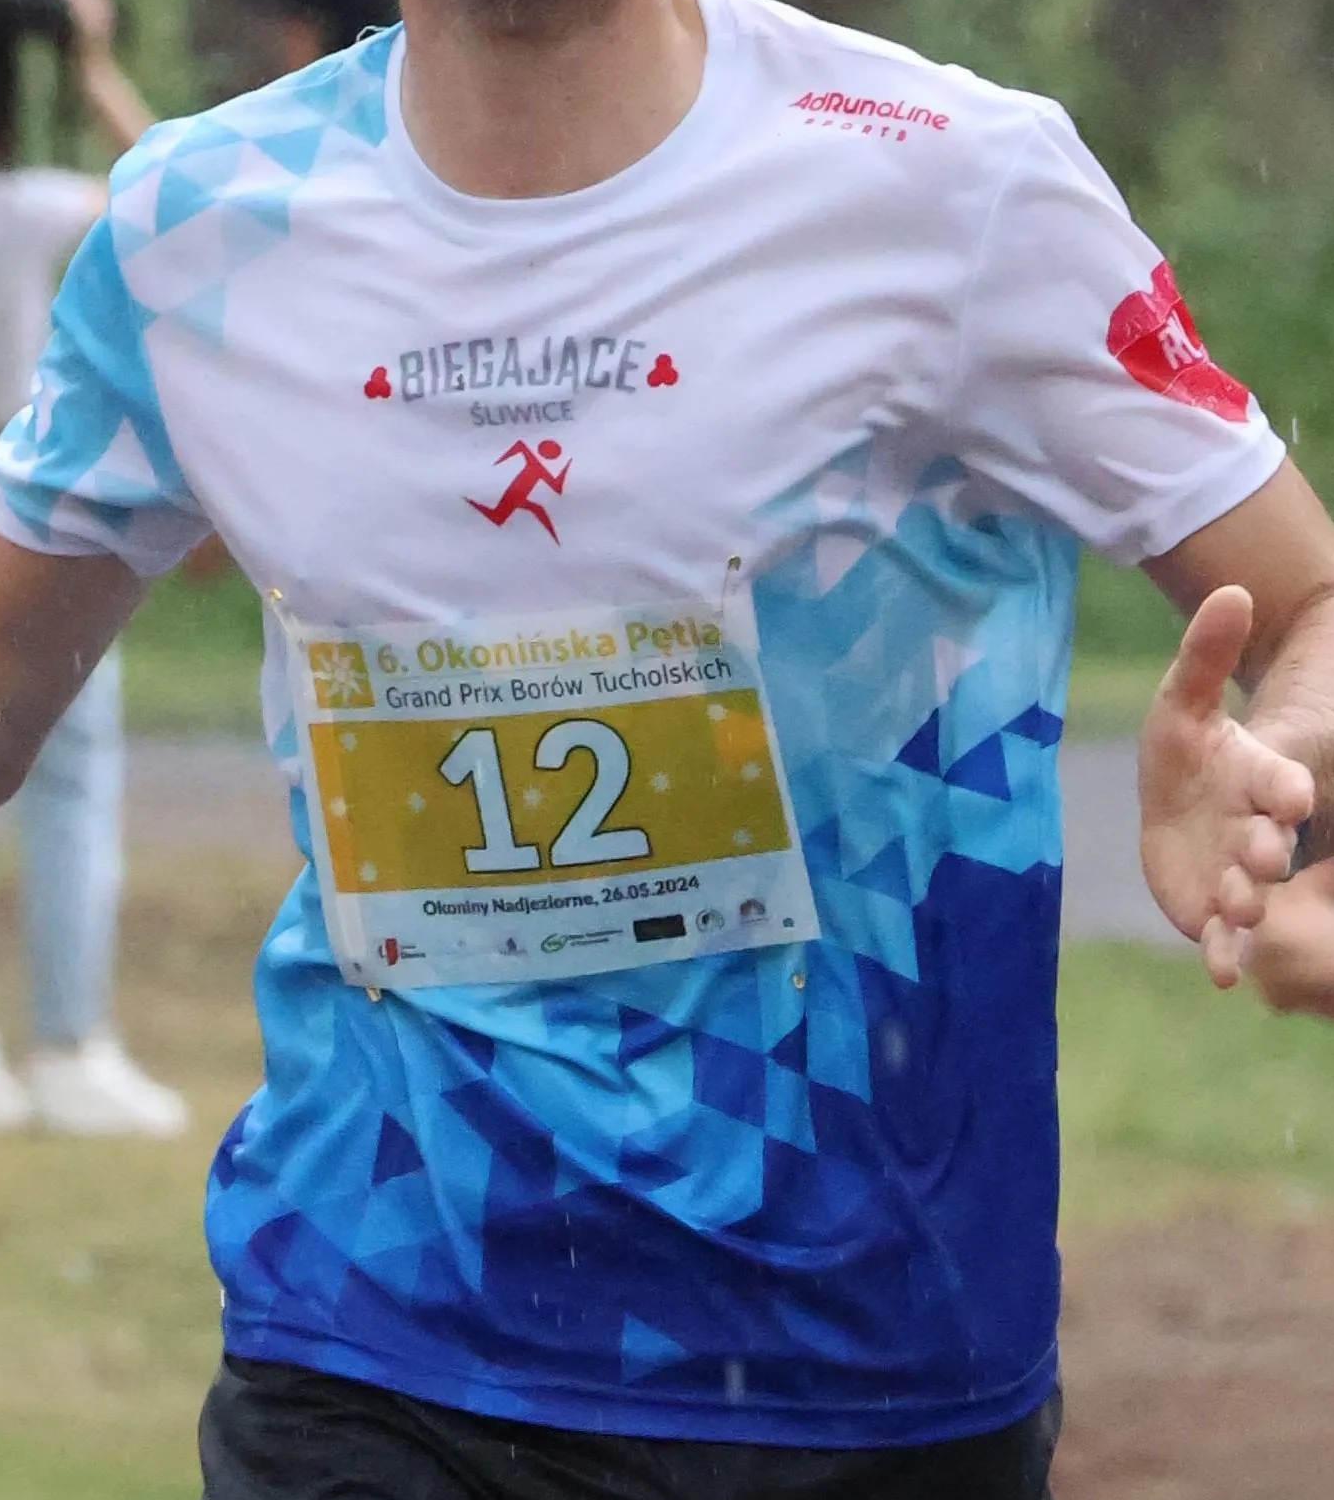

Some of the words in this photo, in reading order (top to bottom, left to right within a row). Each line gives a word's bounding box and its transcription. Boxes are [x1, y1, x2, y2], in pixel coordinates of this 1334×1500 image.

[470, 400, 575, 427] ŚLIWICE
[377, 644, 408, 673] 6.
[417, 629, 616, 672] Okonińska
[625, 617, 722, 657] Pętla
[385, 685, 452, 709] Grand
[460, 681, 503, 706] Prix
[512, 674, 582, 700] Borów
[590, 658, 732, 694] Tucholskich
[438, 718, 652, 875] 12
[423, 899, 488, 916] Okoniny
[601, 875, 700, 902] 26.05.2024
